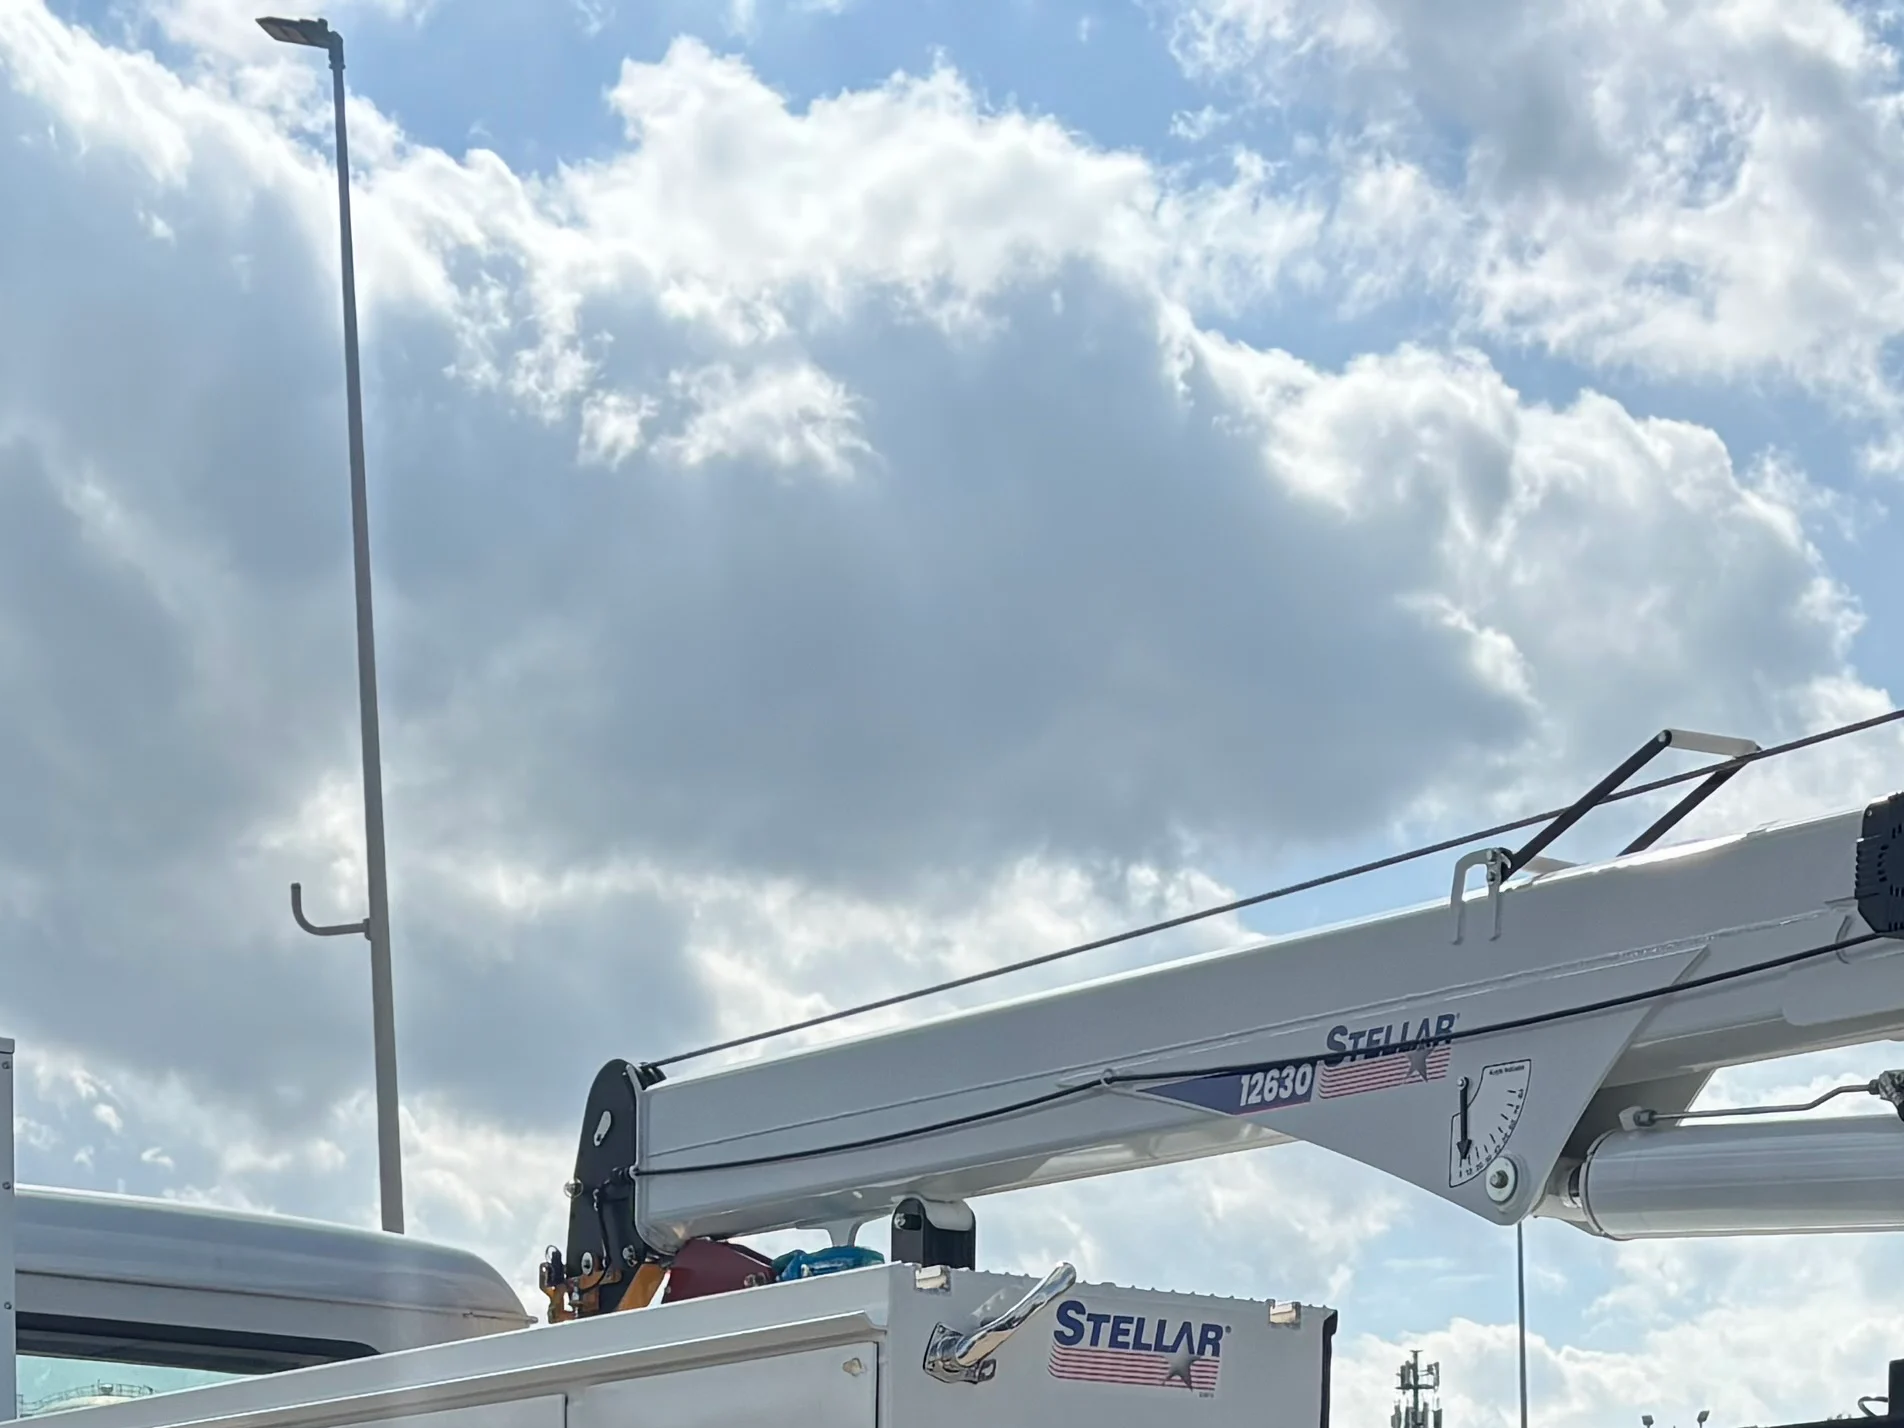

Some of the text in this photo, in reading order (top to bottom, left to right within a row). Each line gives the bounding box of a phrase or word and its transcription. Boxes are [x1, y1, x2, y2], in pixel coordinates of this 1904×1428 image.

[1239, 1013, 1457, 1107] 12630 STELLAR
[1053, 1299, 1225, 1358] STELLAR
